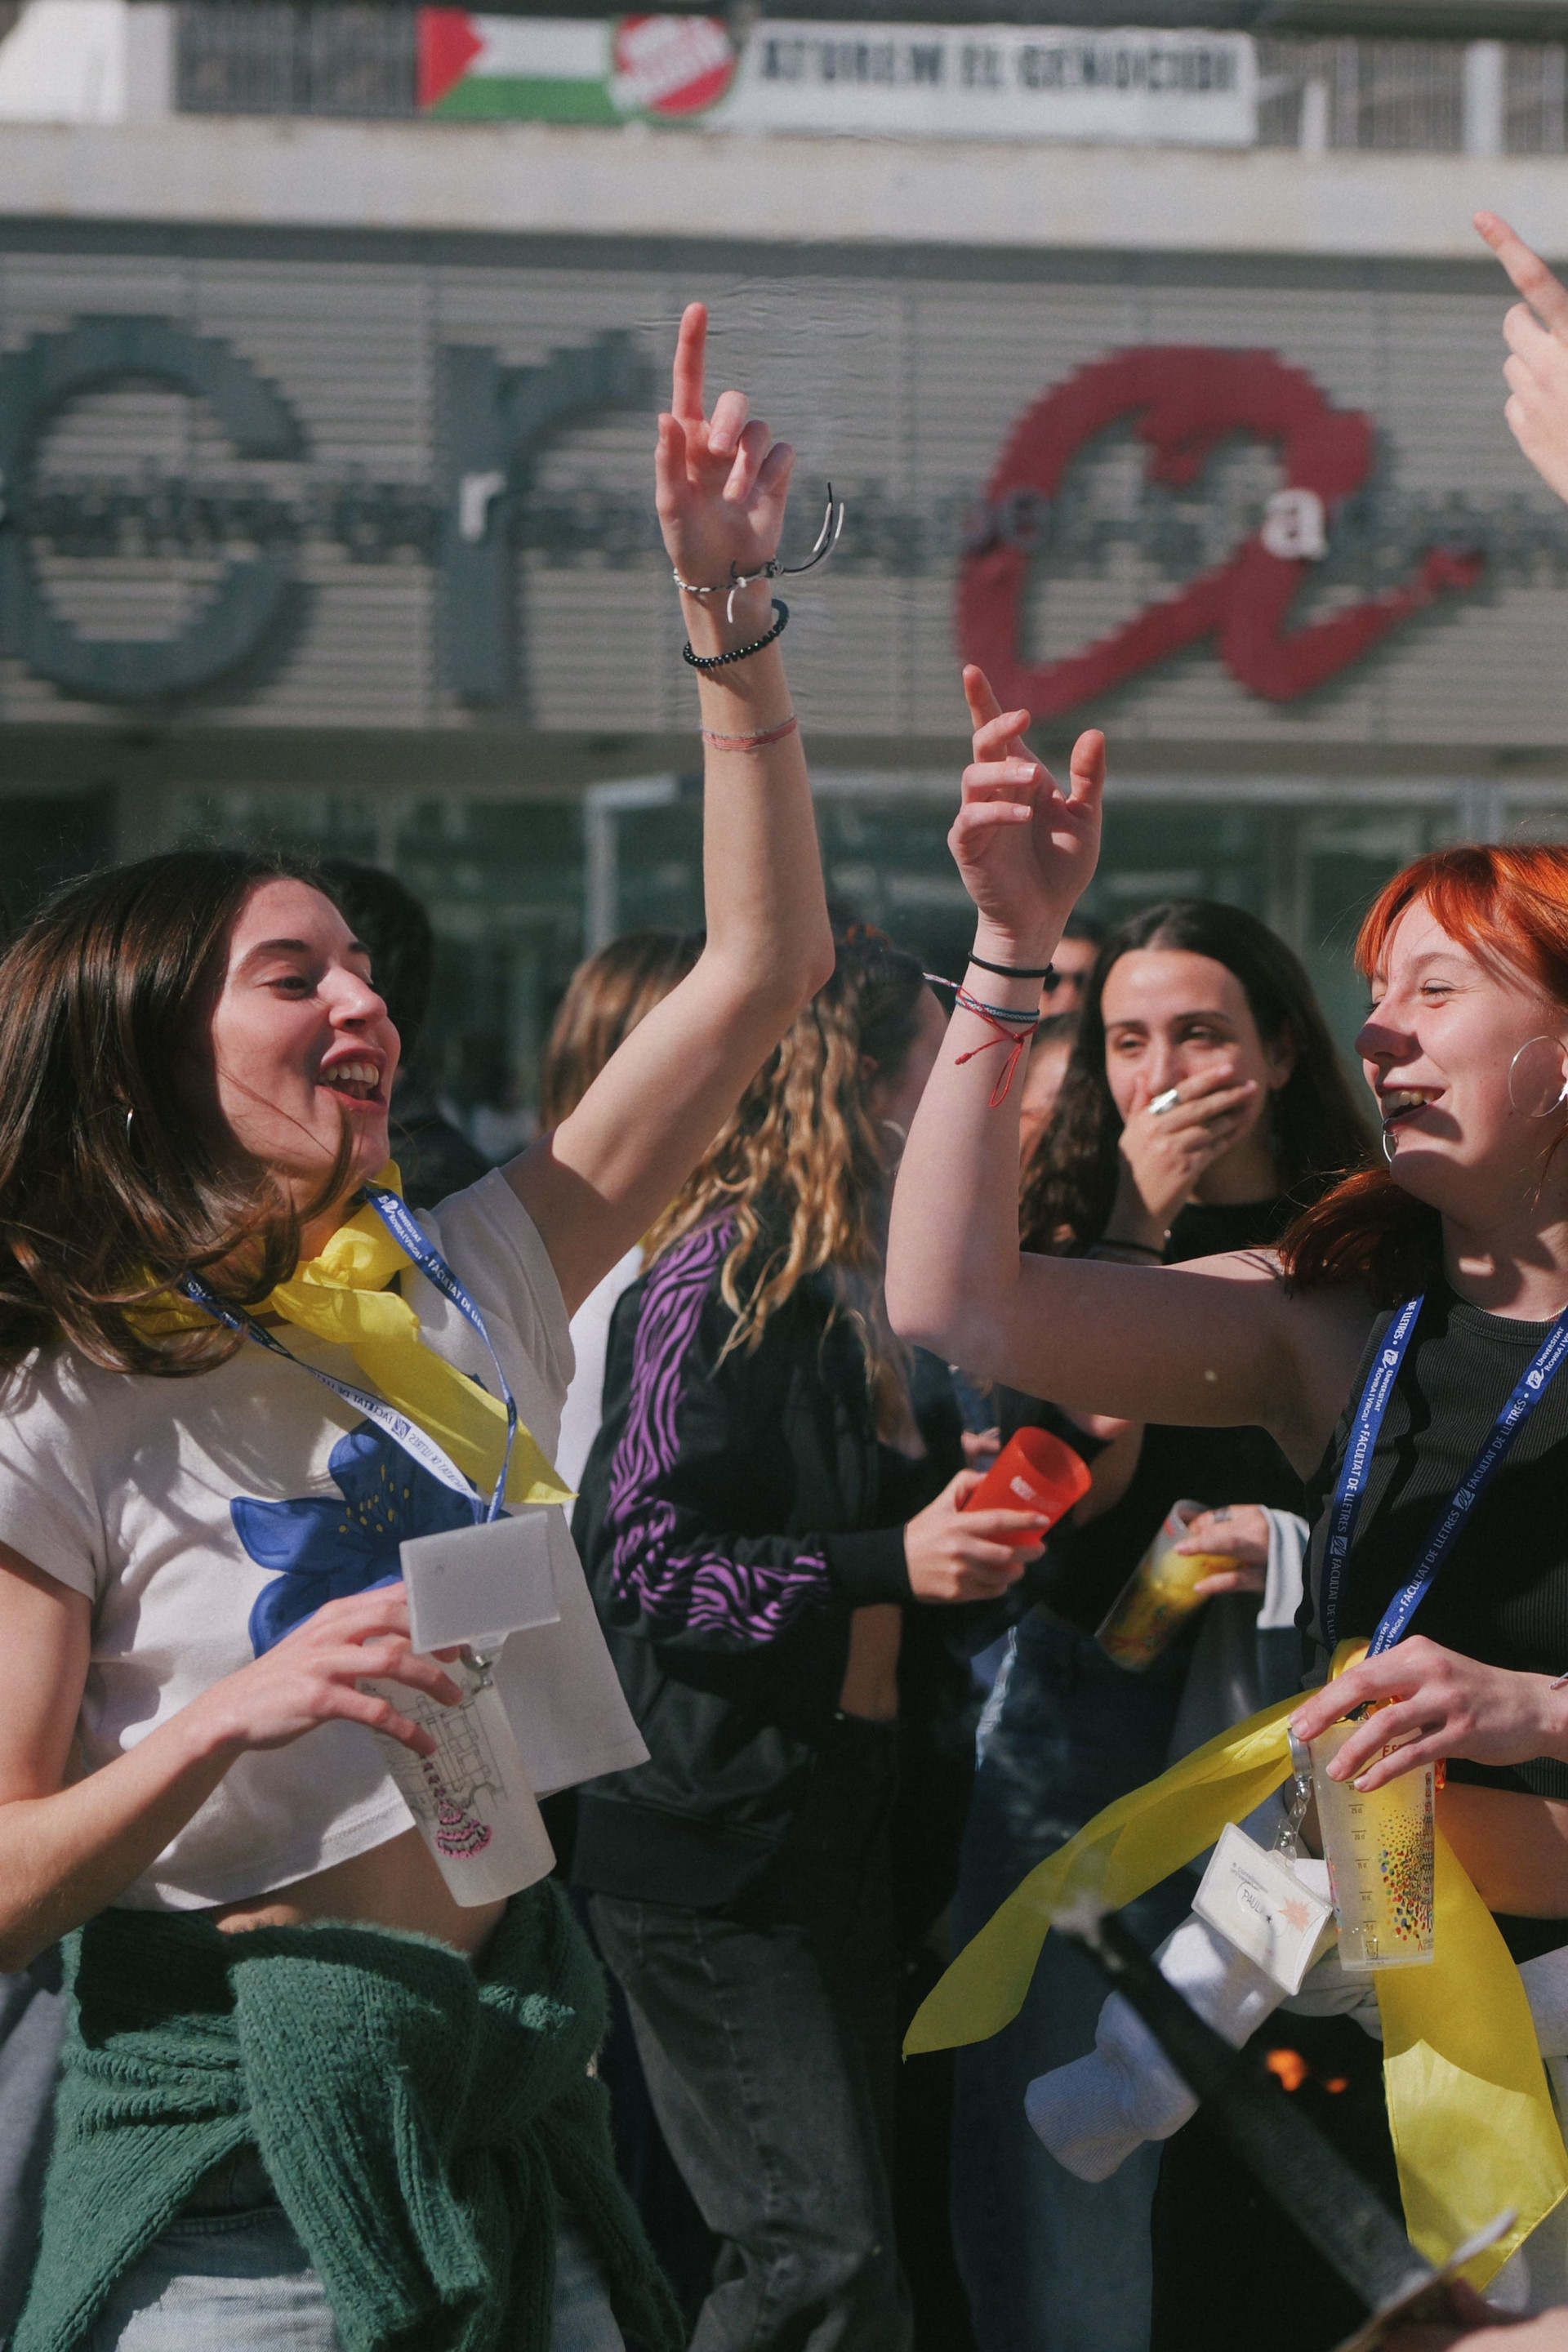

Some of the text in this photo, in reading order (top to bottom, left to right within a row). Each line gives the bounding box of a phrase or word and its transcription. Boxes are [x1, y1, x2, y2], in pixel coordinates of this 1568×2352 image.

[427, 1258, 462, 1299] FACULTAT
[1394, 1301, 1417, 1339] DE LLETRES
[1536, 1326, 1564, 1366] UNIVERSITAT
[1544, 1347, 1564, 1371] ROVIRA
[1370, 1367, 1384, 1392] ROVIRA
[1374, 1370, 1393, 1412] UNIVERSITAT
[1361, 1397, 1374, 1421] VIRGILI
[1467, 1399, 1526, 1490] FACULTAT DE LLETRES
[1338, 1430, 1370, 1532] FACULTAT DE LLETRES
[1401, 1509, 1460, 1607] FACULTAT DE LLETRES
[1328, 1557, 1342, 1601] FACULTAT
[1327, 1604, 1336, 1616] DE
[1389, 1615, 1405, 1637] VIRGILI
